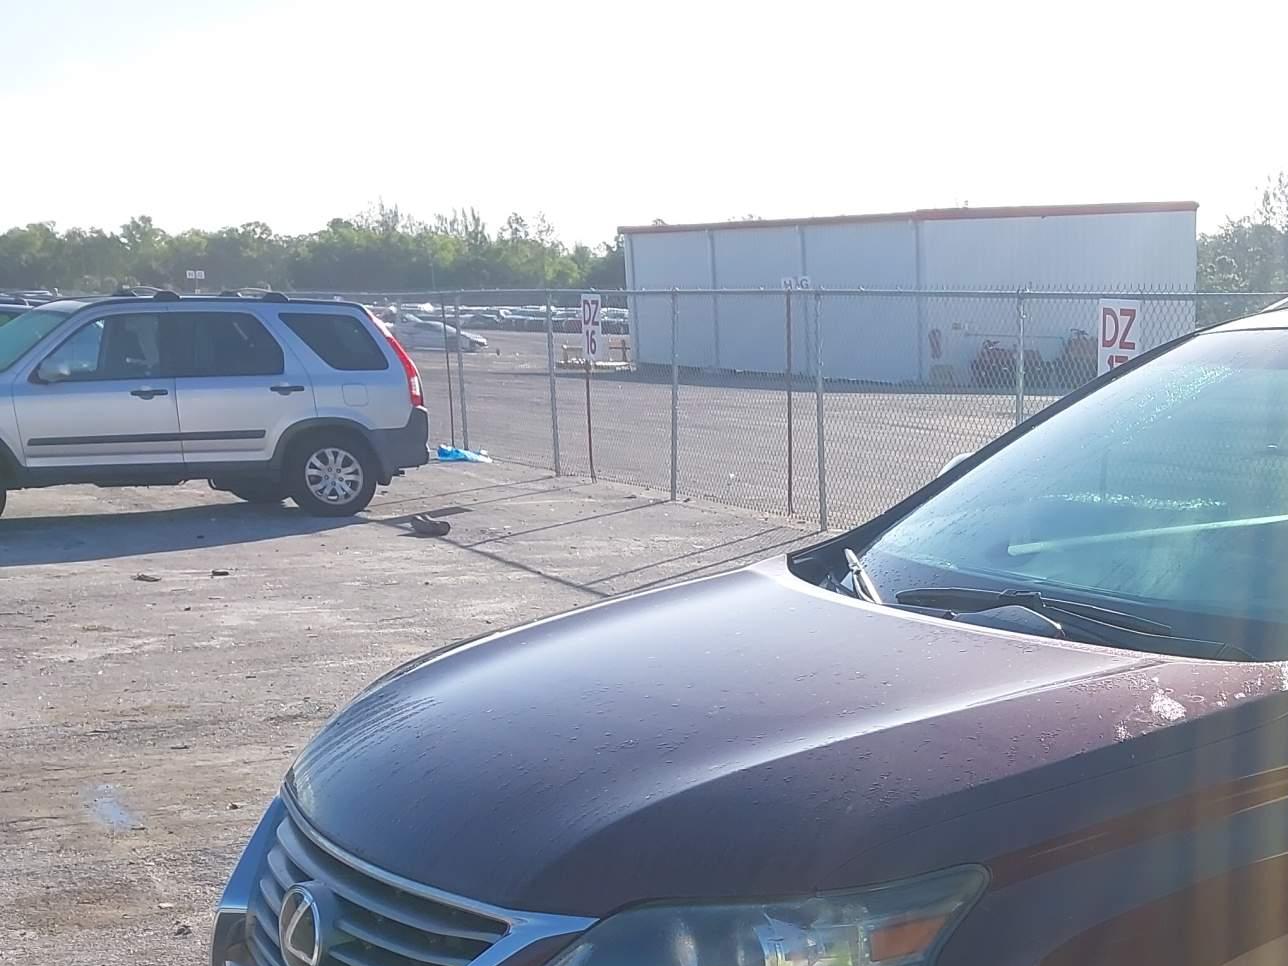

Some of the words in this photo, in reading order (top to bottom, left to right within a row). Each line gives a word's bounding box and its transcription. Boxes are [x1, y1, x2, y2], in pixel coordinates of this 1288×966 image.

[582, 299, 600, 327] DZ
[585, 329, 597, 355] 16
[1102, 307, 1137, 351] DZ
